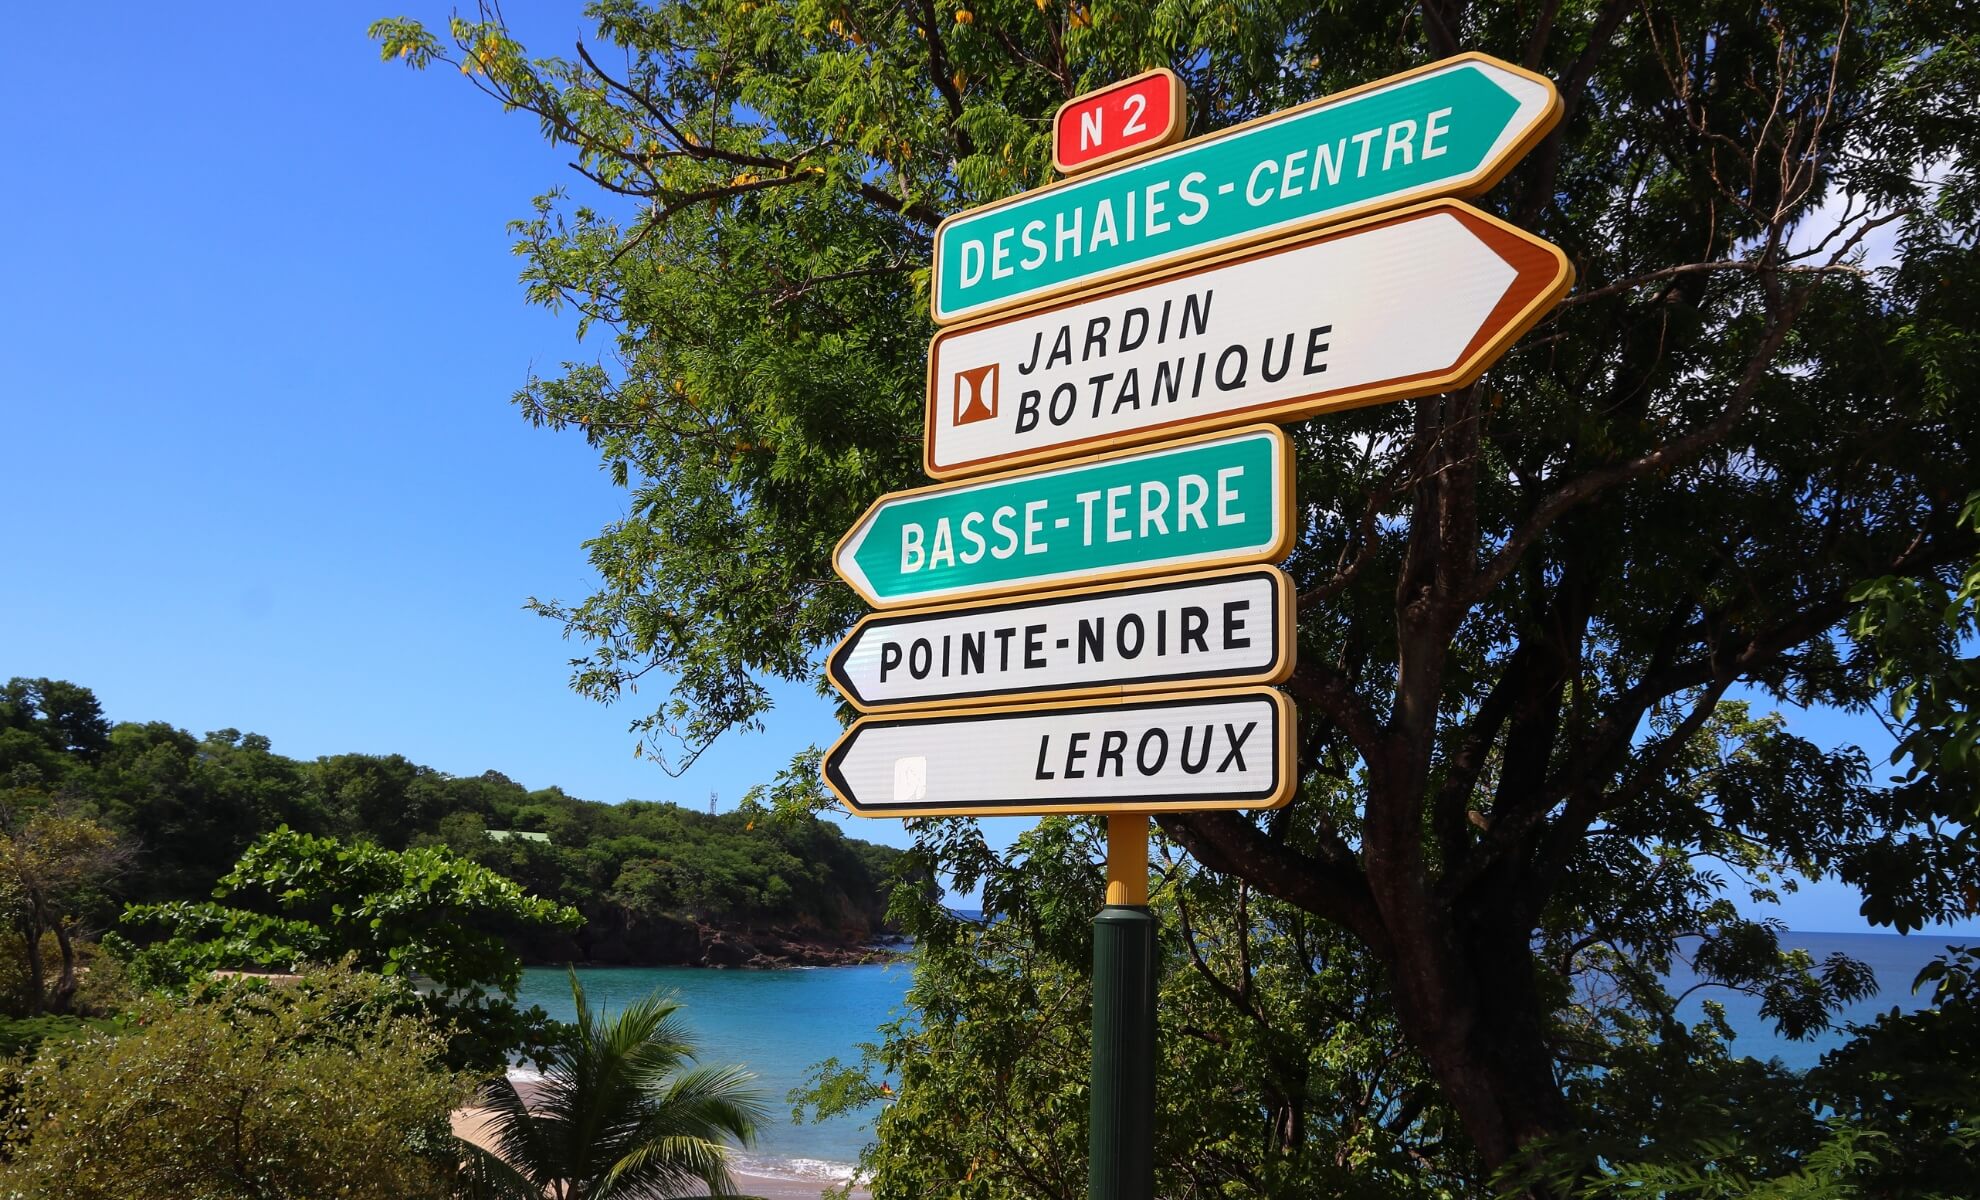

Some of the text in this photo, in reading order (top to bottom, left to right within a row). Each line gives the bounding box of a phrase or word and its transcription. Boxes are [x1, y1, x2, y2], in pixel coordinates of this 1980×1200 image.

[1080, 93, 1147, 152] N 2
[1017, 289, 1214, 376] JARDIN
[1014, 324, 1333, 434] BOTANIQUE
[900, 465, 1246, 574] BASSE-TERRE
[879, 599, 1251, 683] POINTE-NOIRE
[1035, 721, 1258, 781] LEROUX
